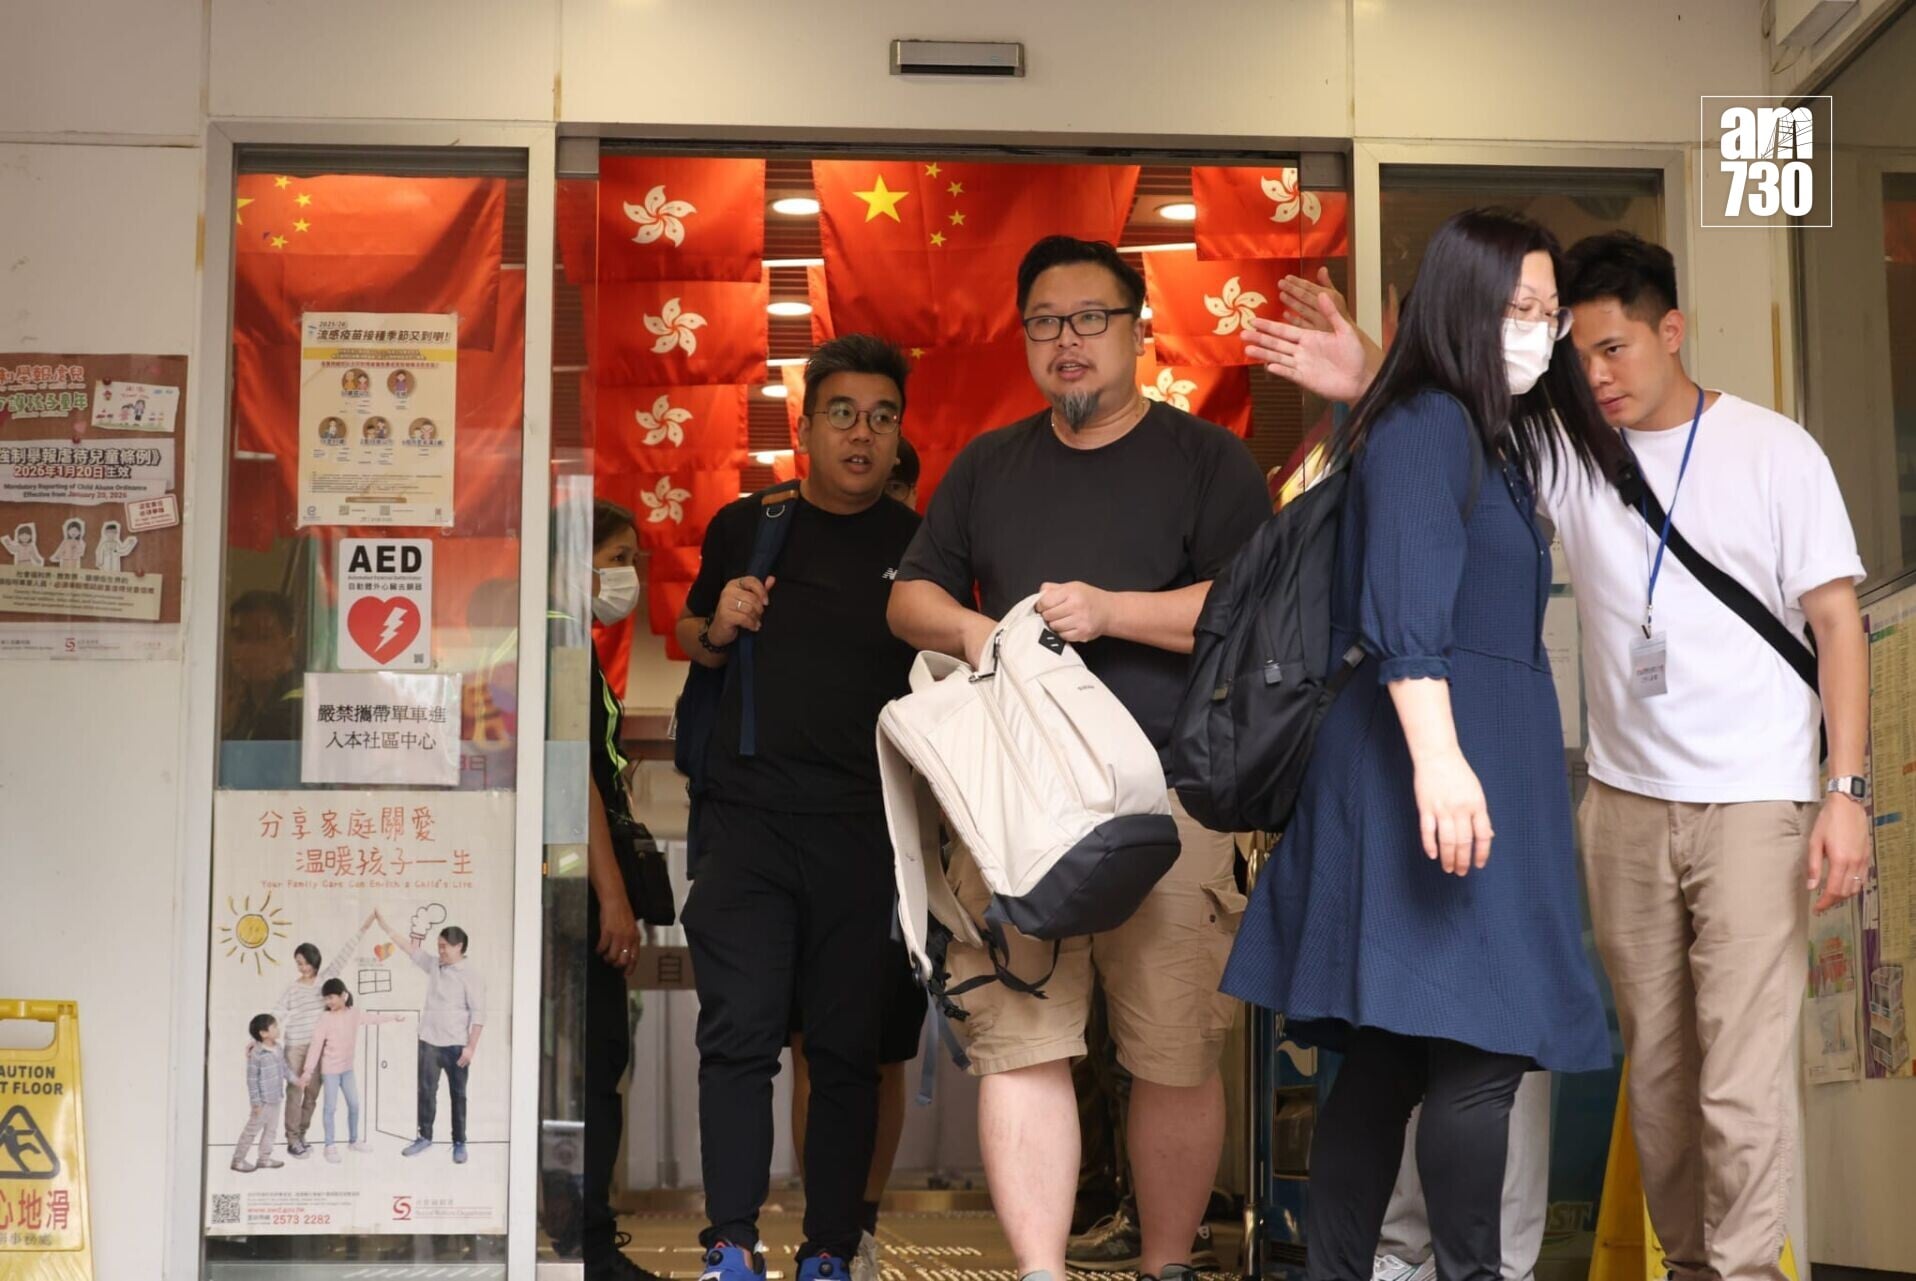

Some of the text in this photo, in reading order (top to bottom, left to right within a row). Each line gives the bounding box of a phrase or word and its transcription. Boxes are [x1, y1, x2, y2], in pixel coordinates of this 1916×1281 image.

[348, 545, 422, 573] AED
[317, 704, 448, 723] 嚴禁攜帶單車進
[326, 731, 437, 751] 入本社區中心
[259, 806, 436, 842] 分享家庭關愛
[262, 880, 282, 889] Your
[287, 880, 318, 889] Family
[322, 880, 344, 889] Care
[13, 1082, 63, 1096] FLOOR
[273, 1214, 299, 1225] 2573
[303, 1214, 331, 1225] 2282
